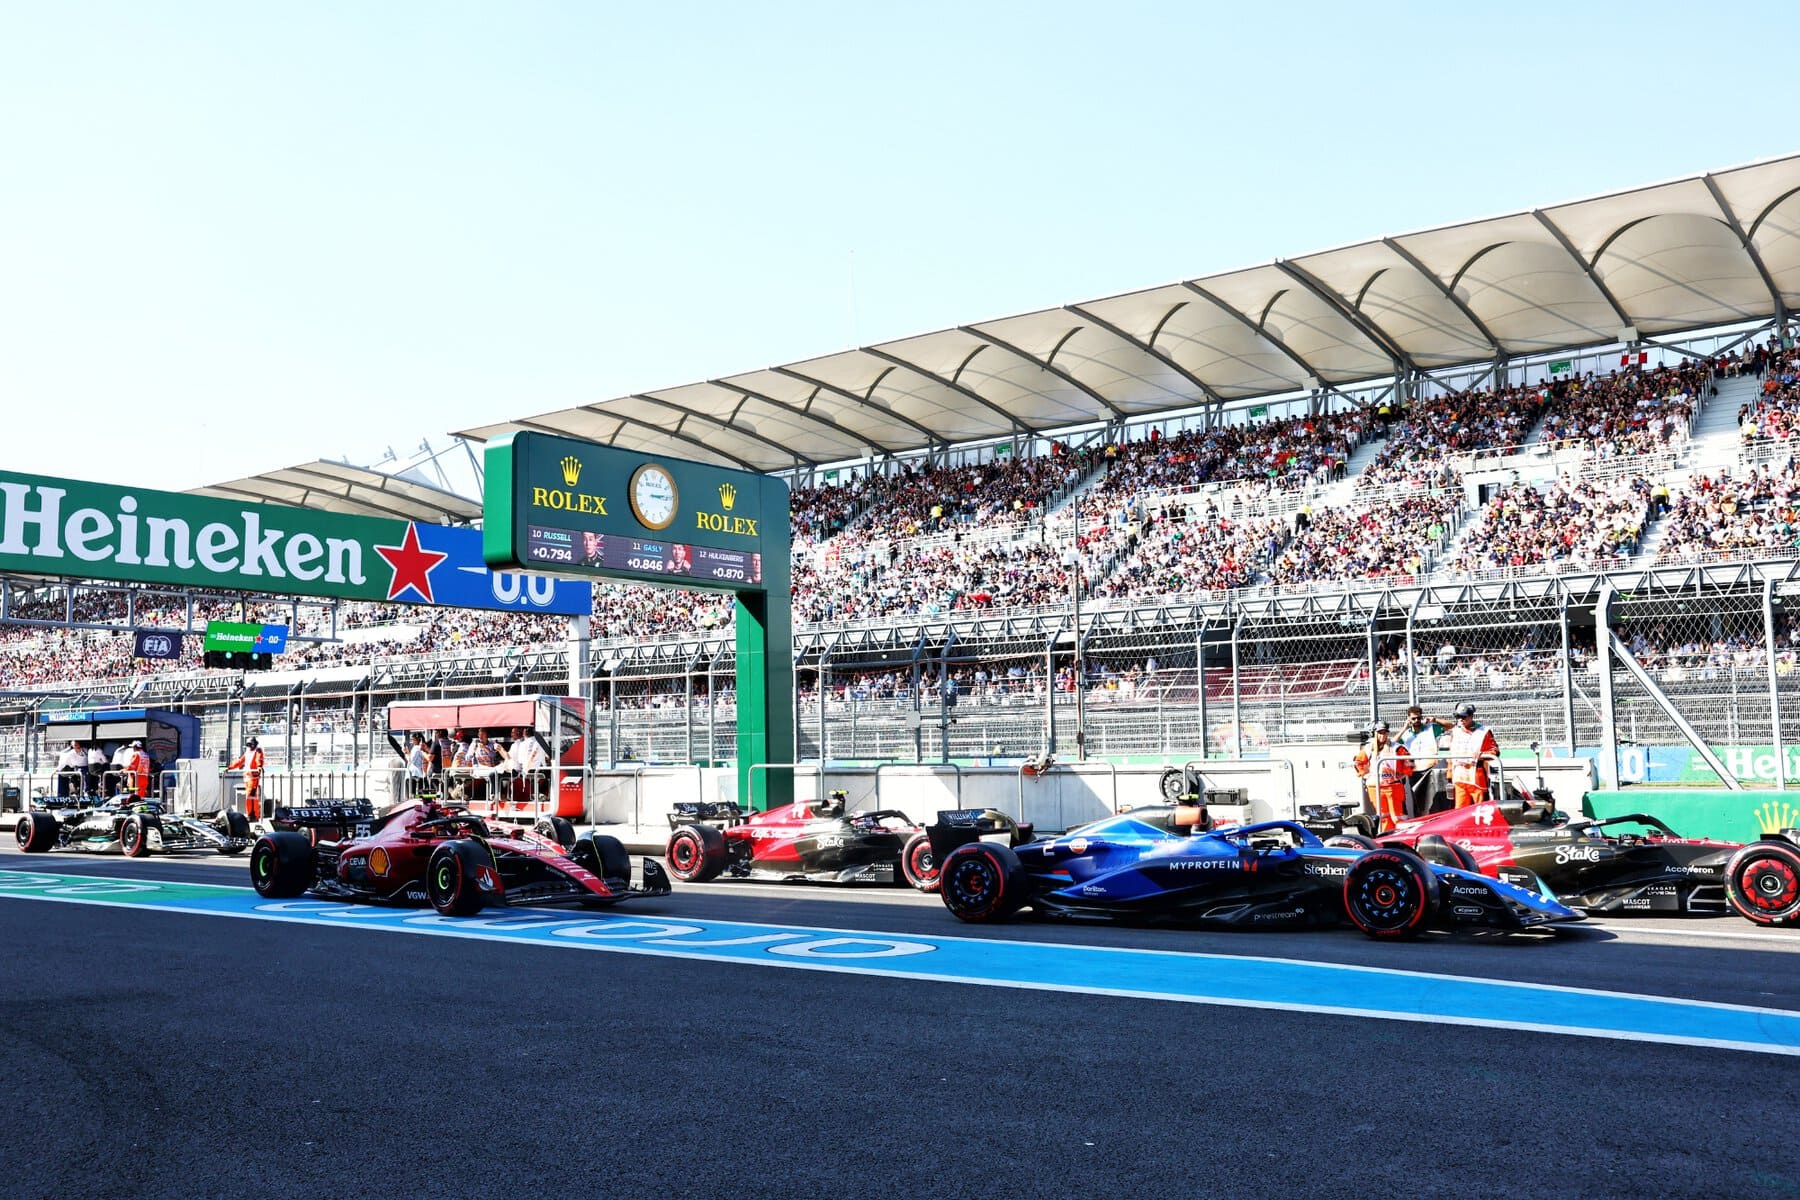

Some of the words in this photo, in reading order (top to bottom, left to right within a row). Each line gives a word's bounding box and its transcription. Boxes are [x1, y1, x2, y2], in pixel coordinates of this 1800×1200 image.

[532, 487, 608, 516] ROLEX
[696, 511, 758, 537] ROLEX
[0, 482, 366, 585] Heineken
[532, 530, 541, 538] 10
[544, 532, 572, 542] RUSSELL
[633, 542, 641, 551] 11
[643, 544, 663, 553] GASLY
[532, 547, 572, 561] +0.794
[627, 559, 663, 571] +0.846
[712, 568, 744, 580] +0.870
[216, 632, 254, 642] Heineken
[356, 824, 371, 839] 55
[816, 834, 844, 850] Stake
[1555, 844, 1600, 865] Stake
[350, 857, 366, 866] CEVA
[1169, 860, 1240, 871] MYPROTEIN
[407, 891, 428, 900] VGW
[1453, 886, 1488, 895] Acronis
